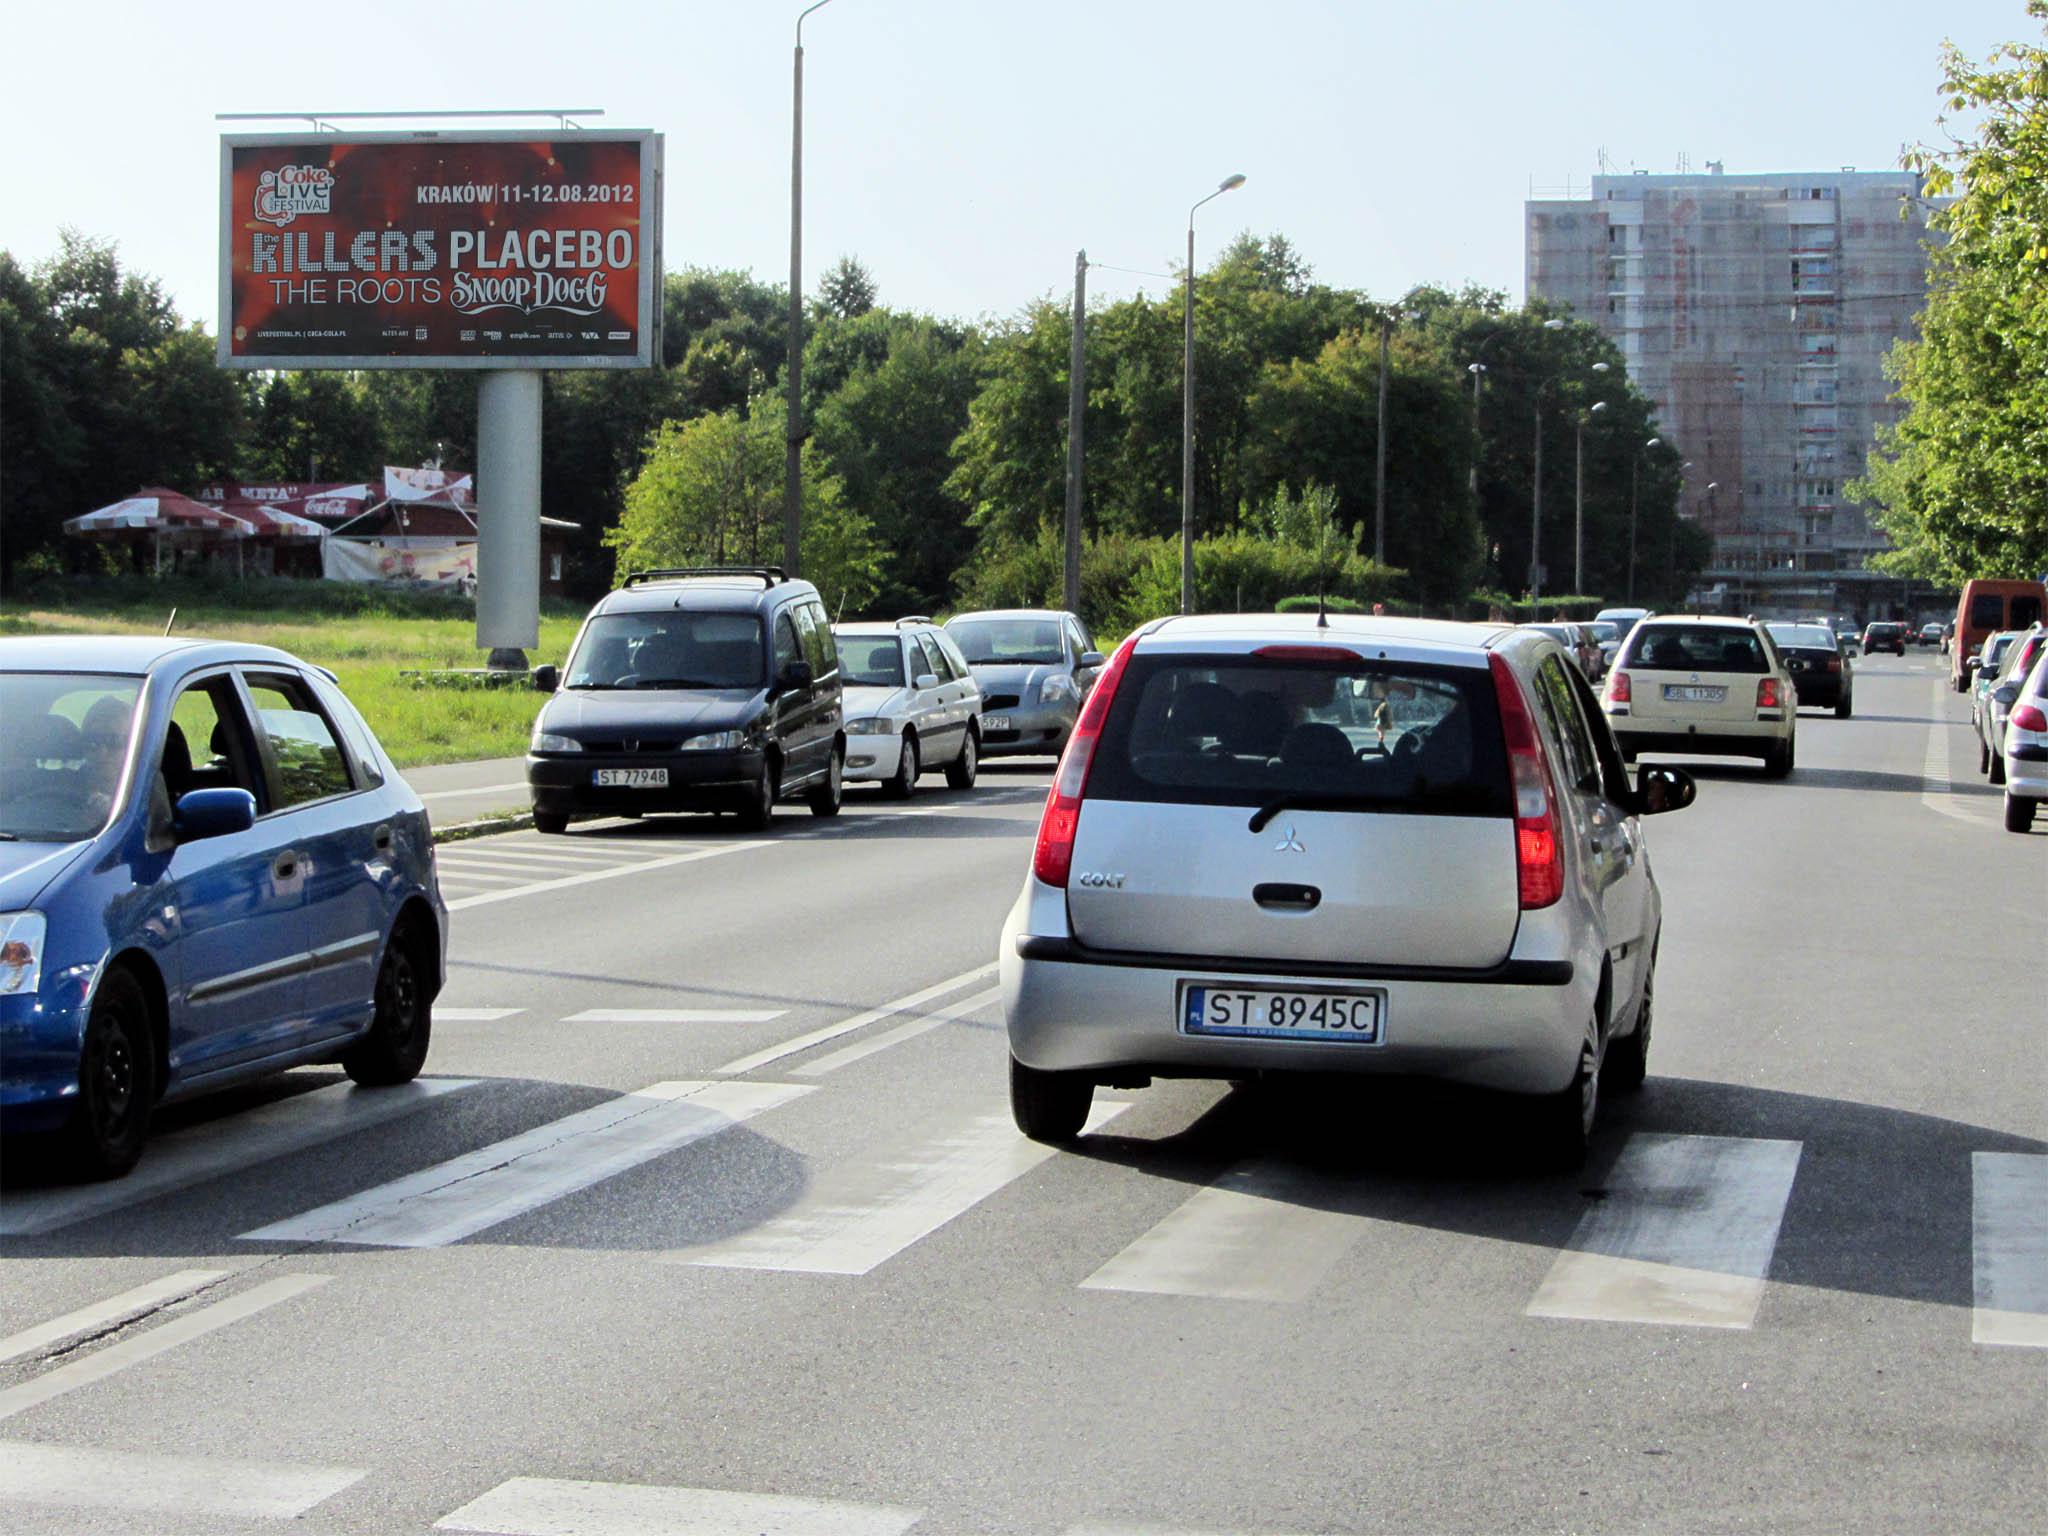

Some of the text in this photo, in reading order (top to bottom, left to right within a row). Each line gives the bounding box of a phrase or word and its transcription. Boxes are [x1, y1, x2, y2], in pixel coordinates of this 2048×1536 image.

[280, 166, 328, 185] Coke
[417, 181, 634, 204] KRAKÓW 11-12.08.2012
[274, 200, 328, 211] FESTIVAL
[263, 233, 280, 243] the
[253, 230, 437, 273] KILLERS
[450, 229, 633, 270] PLACEBO
[269, 278, 441, 304] THE ROOTS
[600, 770, 666, 784] ST 77948
[1080, 871, 1125, 889] COLT
[1190, 1011, 1202, 1021] PL
[1210, 993, 1370, 1030] ST 8945C
